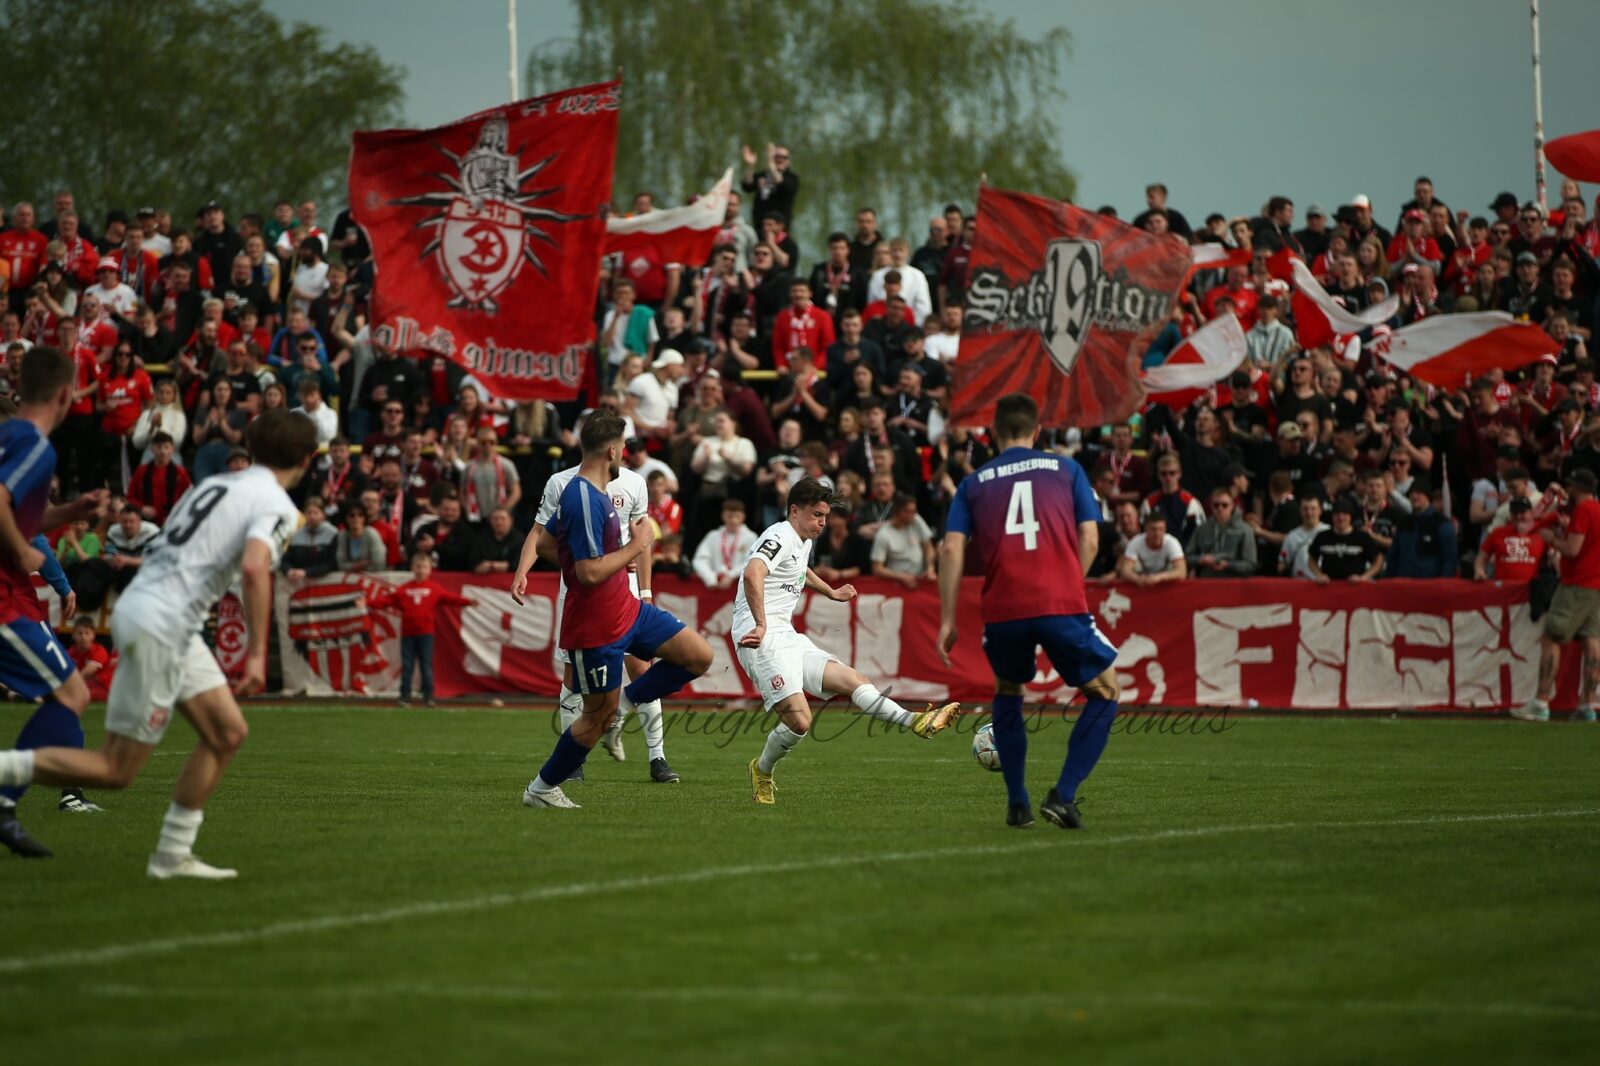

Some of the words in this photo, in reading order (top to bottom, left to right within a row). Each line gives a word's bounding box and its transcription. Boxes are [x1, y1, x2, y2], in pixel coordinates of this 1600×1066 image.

[997, 458, 1060, 478] MERSEBURG
[1005, 480, 1040, 551] 4
[589, 664, 608, 688] 17
[1193, 603, 1600, 708] FIGH
